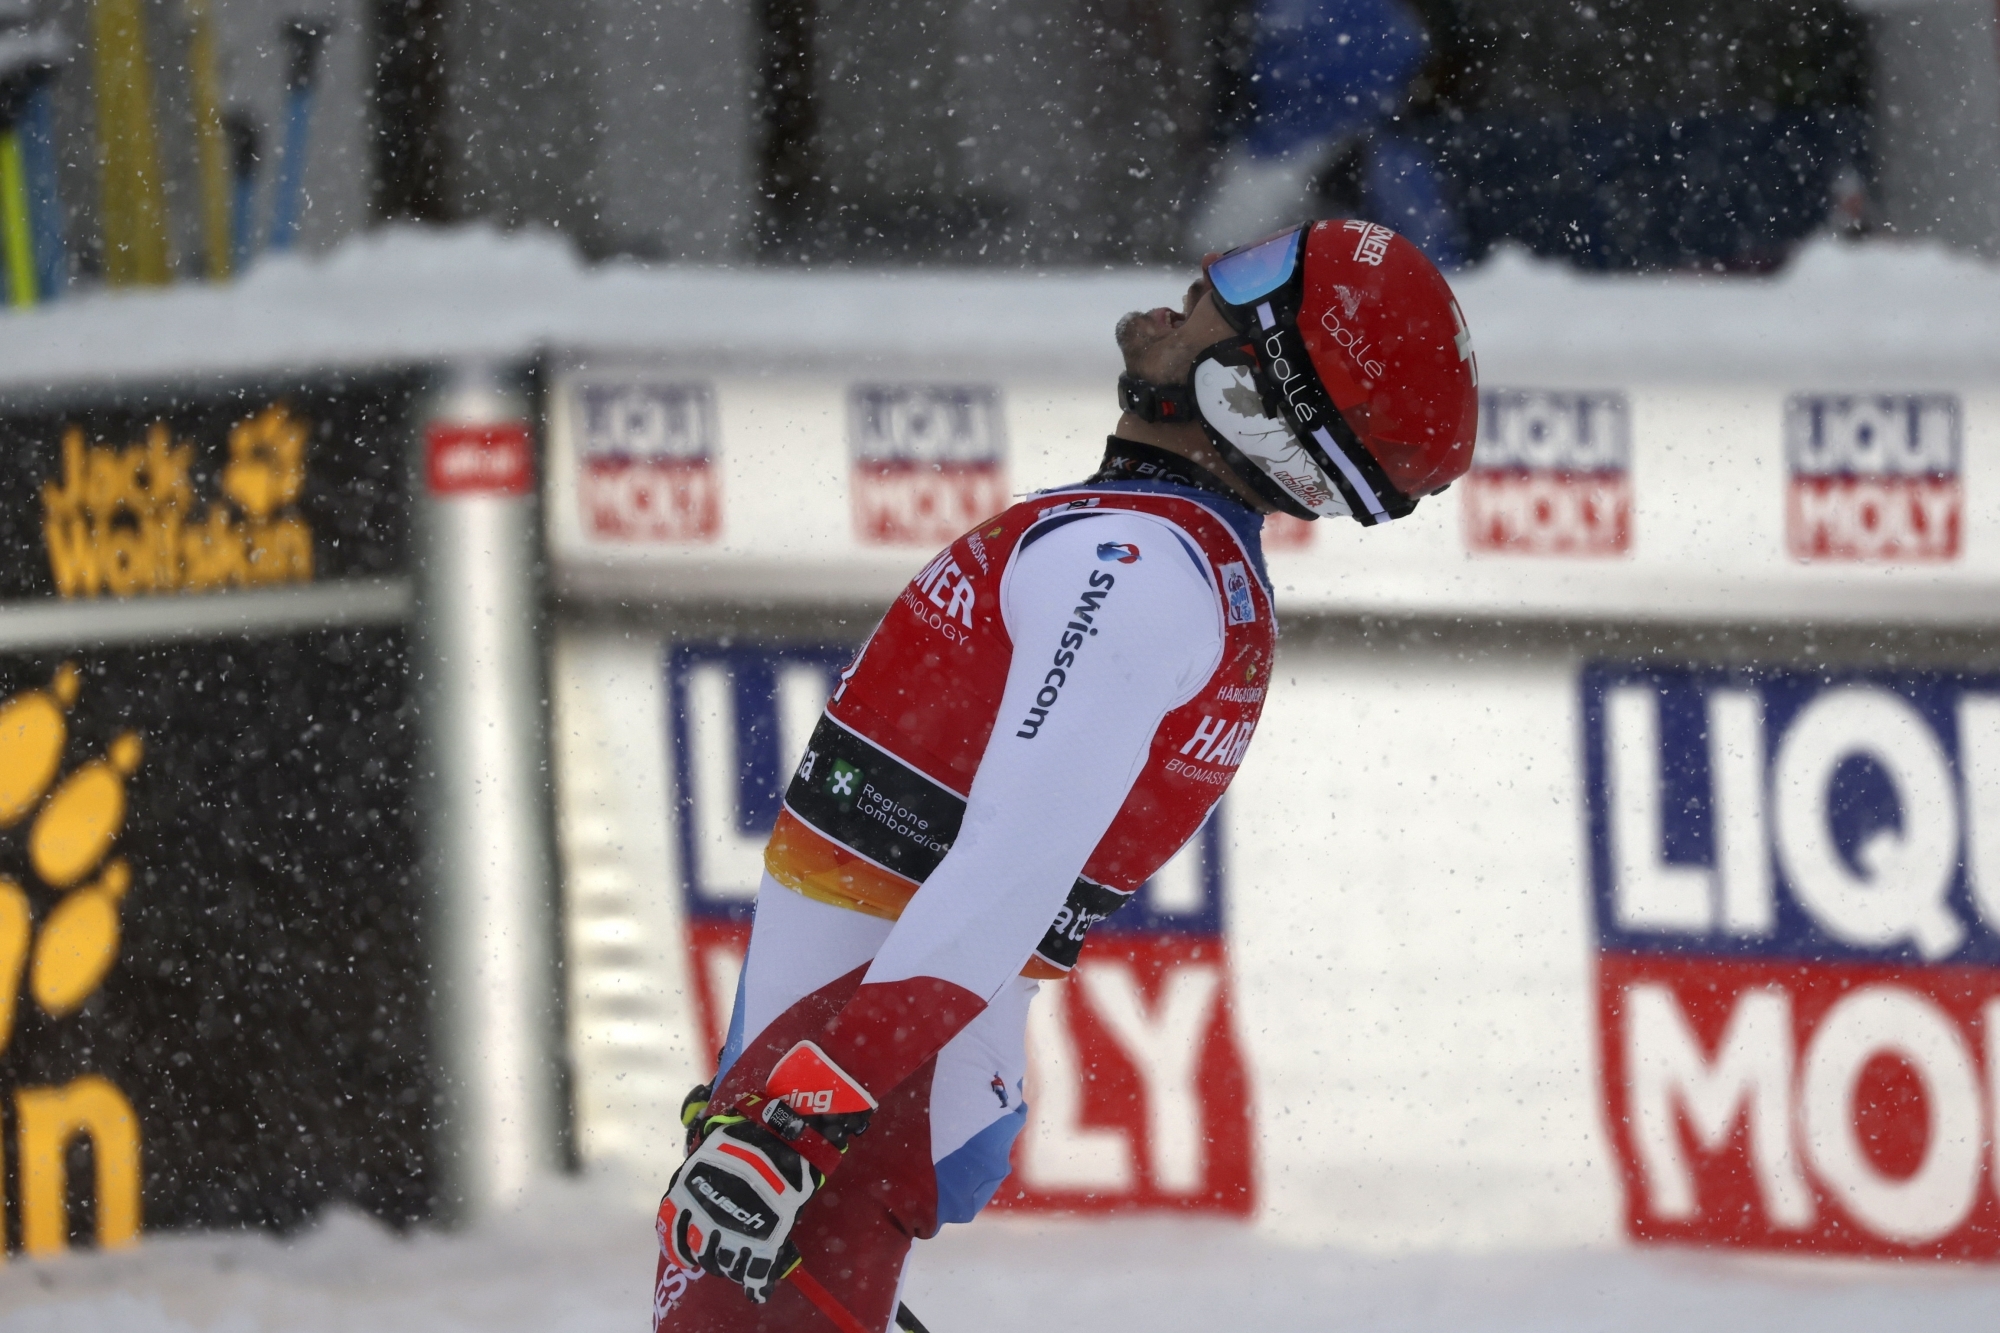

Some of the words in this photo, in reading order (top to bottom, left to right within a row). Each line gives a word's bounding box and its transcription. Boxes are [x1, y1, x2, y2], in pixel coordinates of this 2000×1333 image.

[1266, 331, 1318, 423] bollé
[1321, 306, 1383, 379] bollé
[1016, 569, 1115, 740] swisscom
[856, 797, 943, 852] Lombardia
[862, 783, 929, 830] Regione
[1623, 984, 2000, 1244] MO
[691, 1175, 766, 1230] reusch
